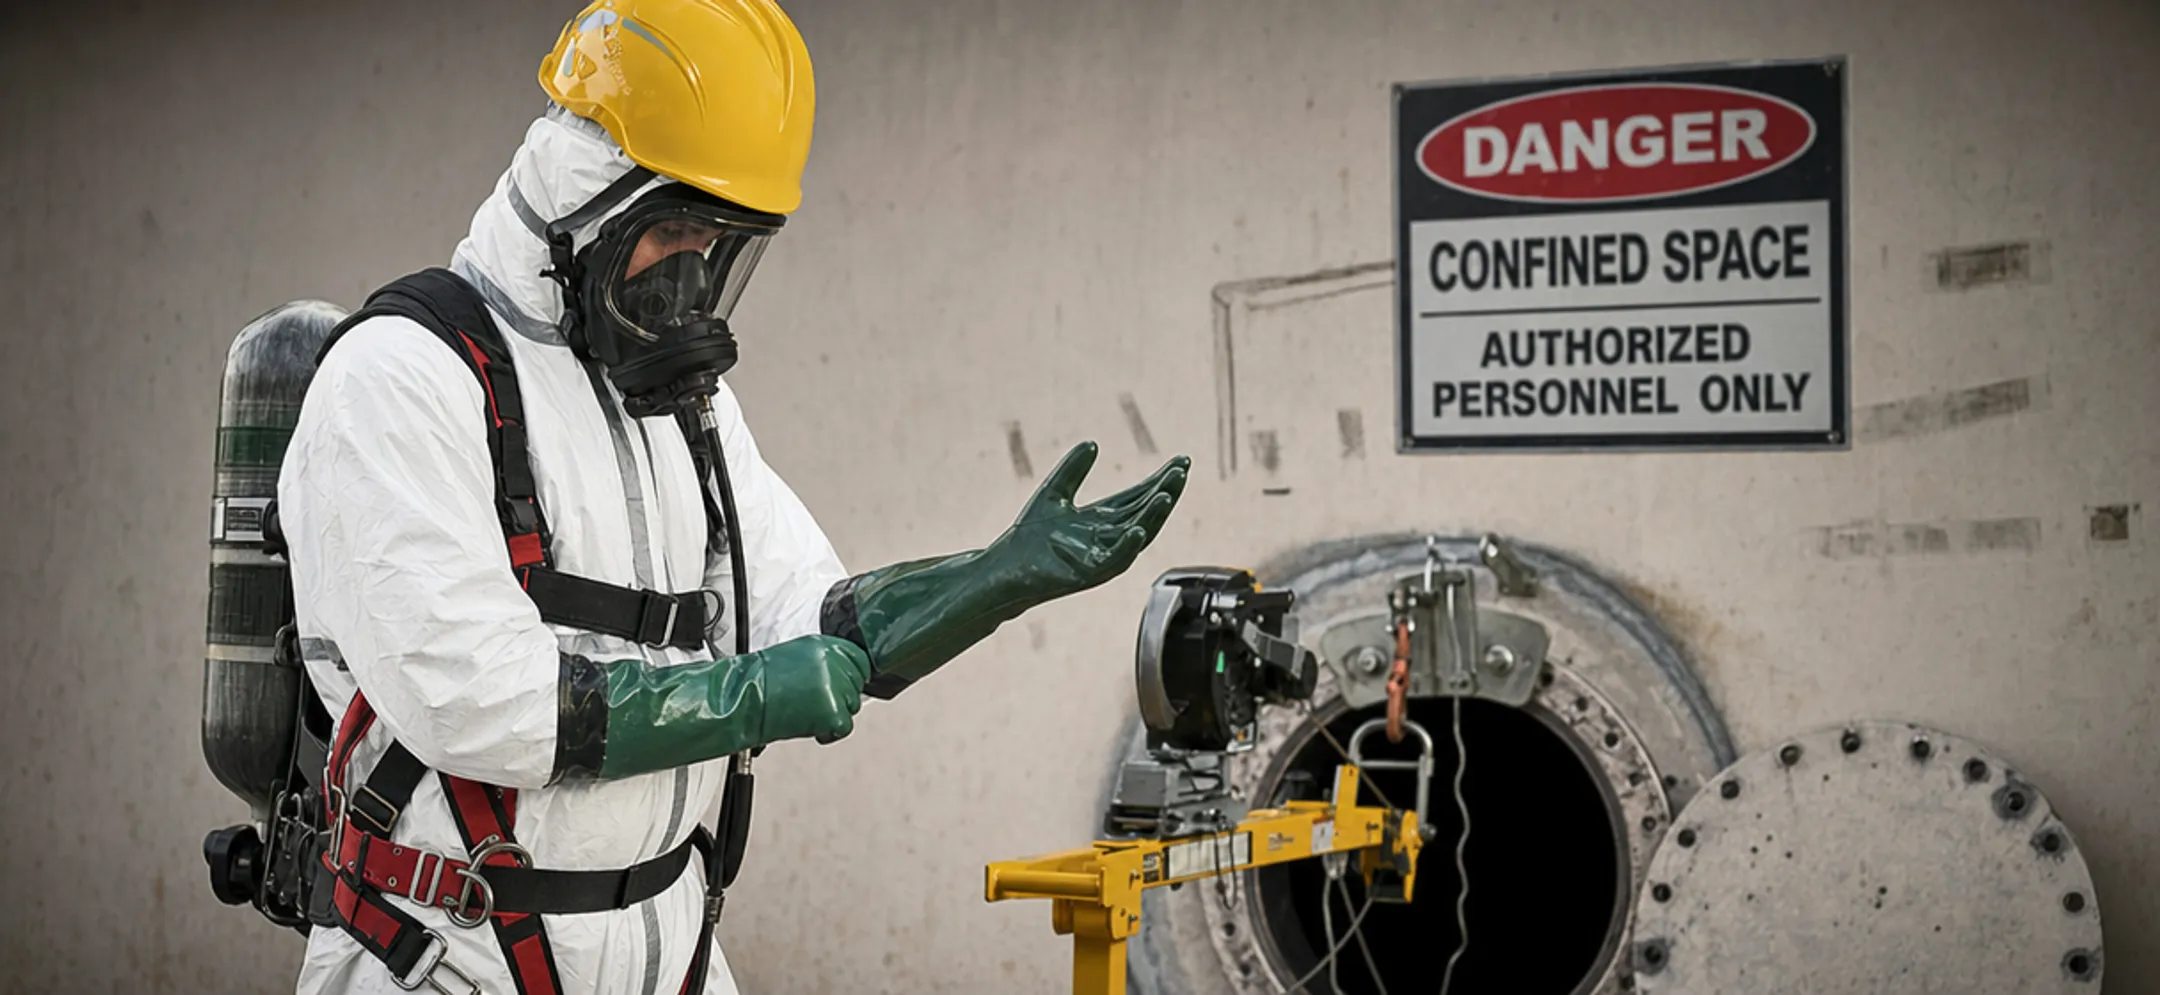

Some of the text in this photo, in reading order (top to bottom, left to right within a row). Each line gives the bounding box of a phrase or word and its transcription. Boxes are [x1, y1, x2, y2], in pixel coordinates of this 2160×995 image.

[1463, 108, 1772, 178] DANGER
[1429, 224, 1811, 293] CONFINED SPACE
[1480, 323, 1752, 368] AUTHORIZED
[1432, 372, 1812, 419] PERSONNEL ONLY
